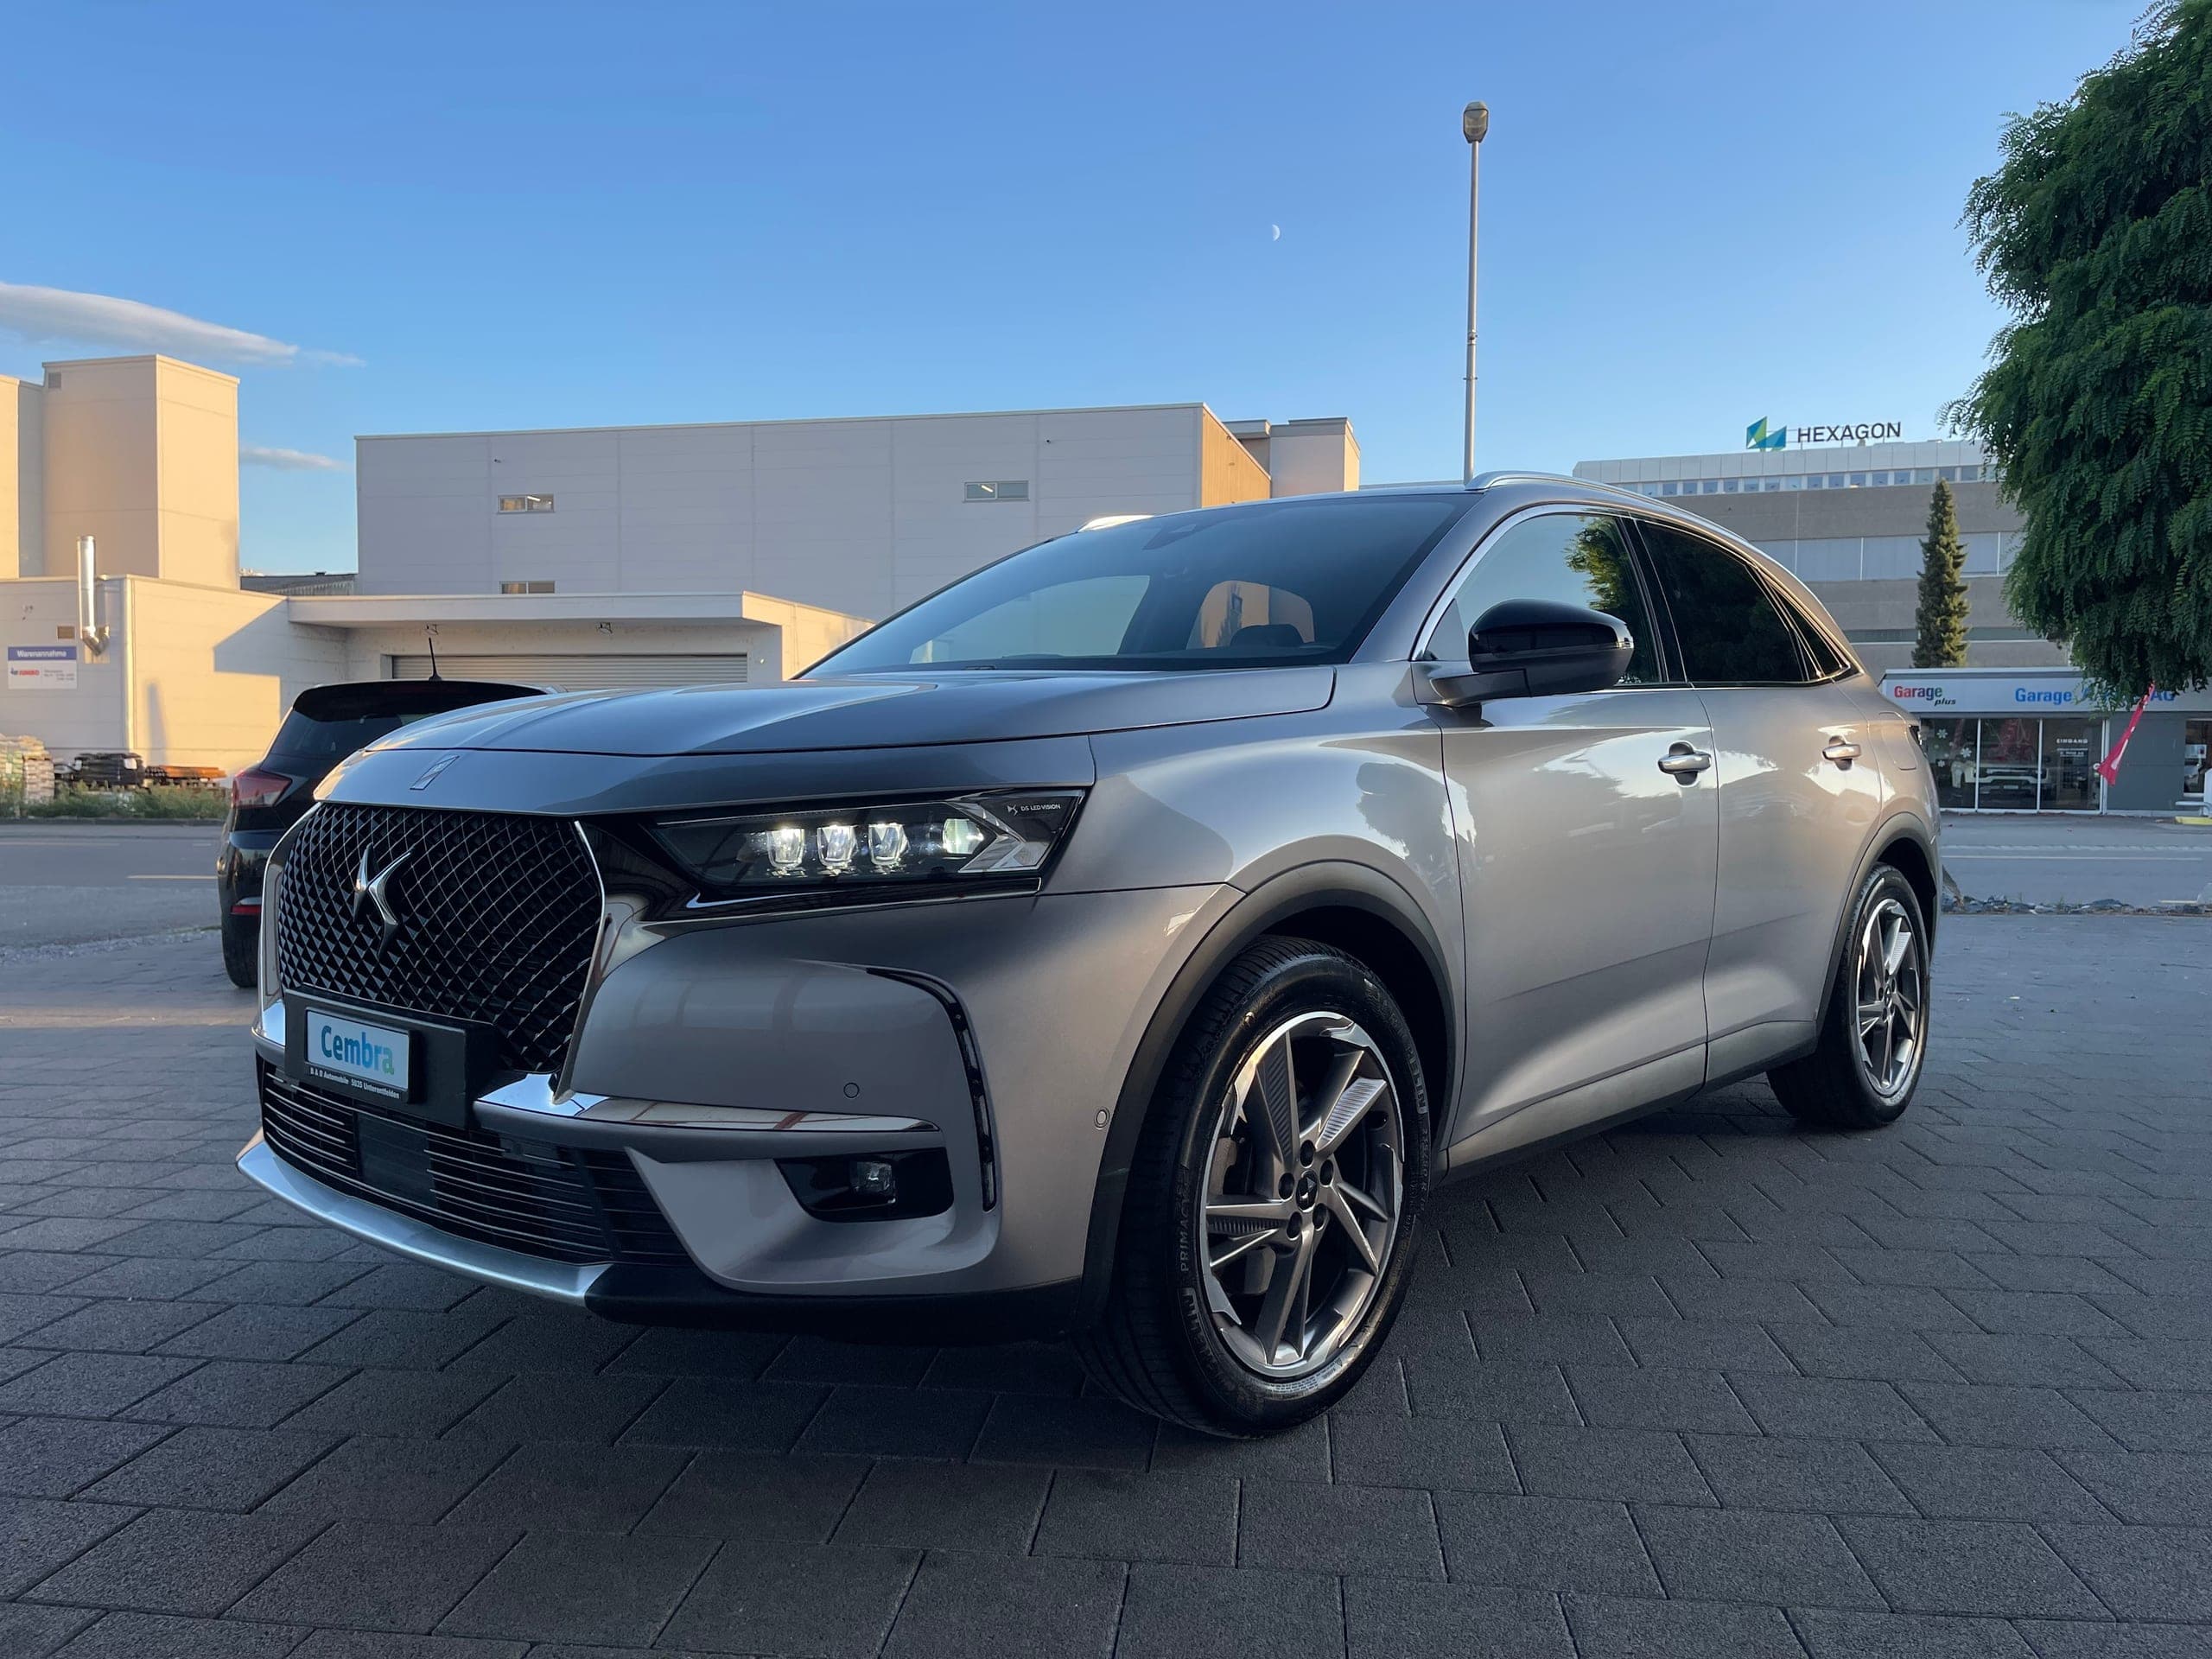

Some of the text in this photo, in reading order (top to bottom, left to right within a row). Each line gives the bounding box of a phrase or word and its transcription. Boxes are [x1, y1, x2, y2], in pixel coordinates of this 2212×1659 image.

[1798, 422, 1901, 443] HEXAGON
[1894, 685, 1943, 701] Garage
[1934, 697, 1956, 707] plus
[2015, 687, 2072, 705] Garage
[321, 1025, 395, 1075] Cembra
